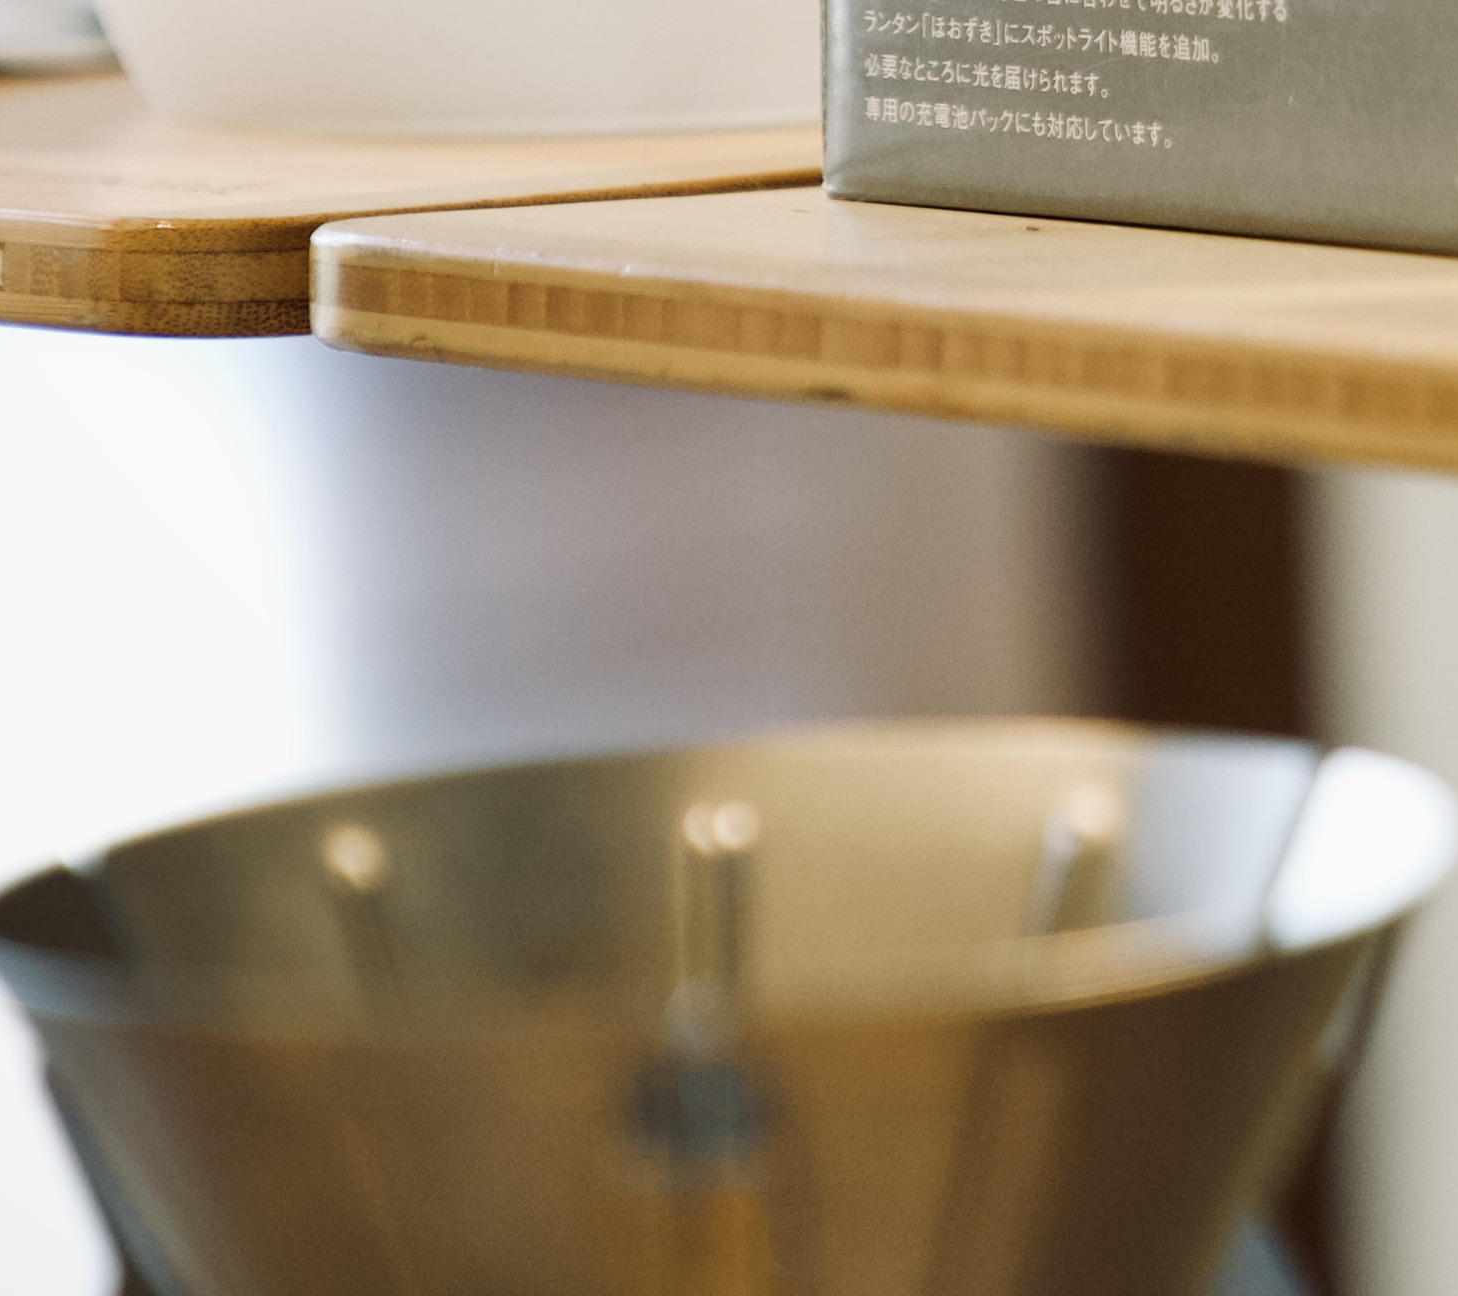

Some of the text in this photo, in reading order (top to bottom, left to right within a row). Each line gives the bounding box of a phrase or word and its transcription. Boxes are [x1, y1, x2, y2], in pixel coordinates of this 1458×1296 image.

[863, 9, 1220, 64] ランタン「ほおずき」にスポットライト機能を追加。
[864, 52, 1109, 99] 必要なところに光を届けられます。
[864, 95, 1172, 149] 専用の充電池パックにも対応しています。
